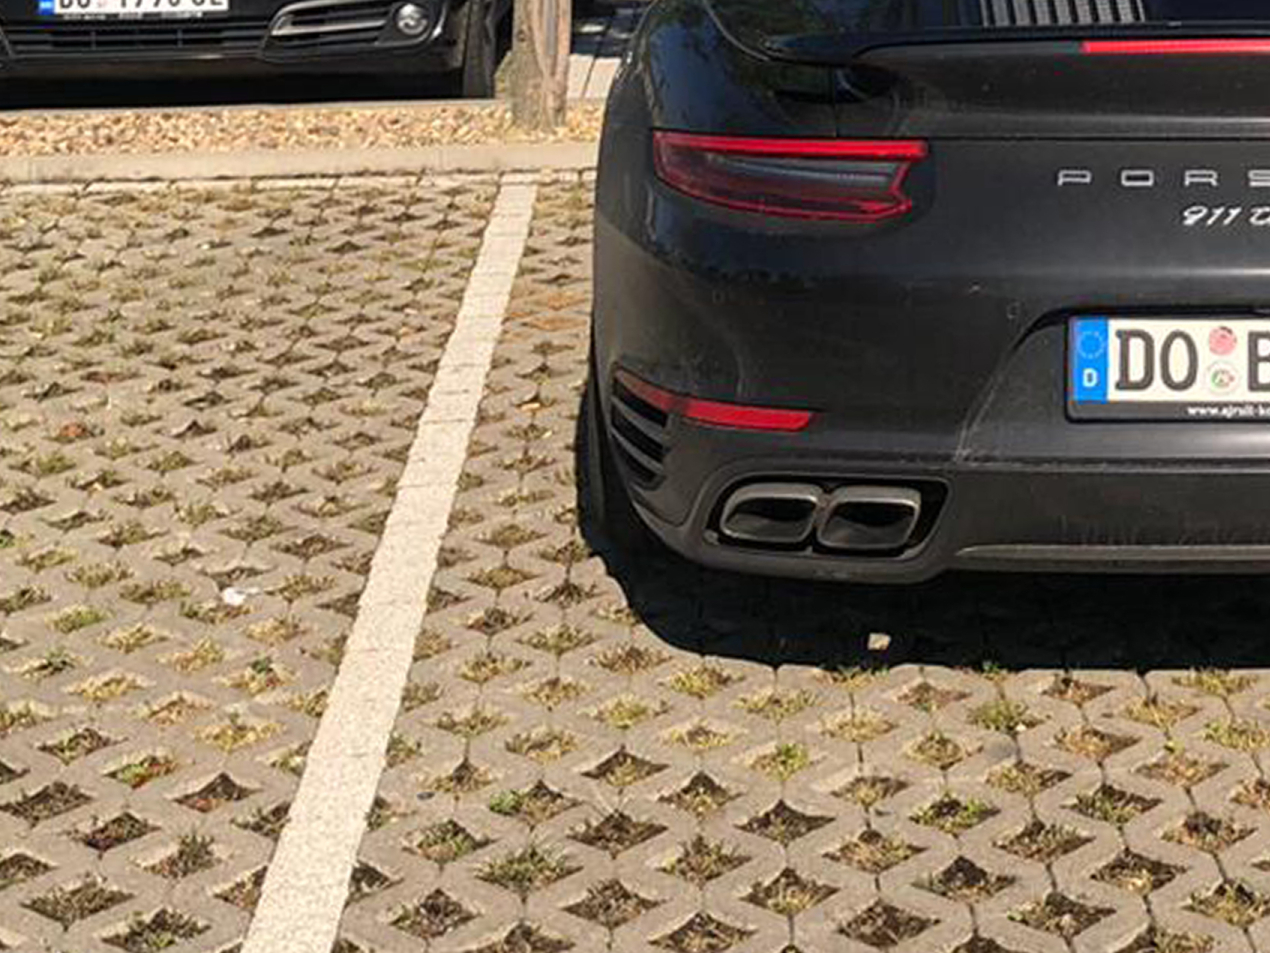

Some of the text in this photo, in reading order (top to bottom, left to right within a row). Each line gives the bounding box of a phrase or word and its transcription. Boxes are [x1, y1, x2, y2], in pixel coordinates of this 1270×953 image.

[1182, 206, 1243, 225] 911
[1082, 369, 1098, 387] D
[1115, 329, 1199, 391] DO
